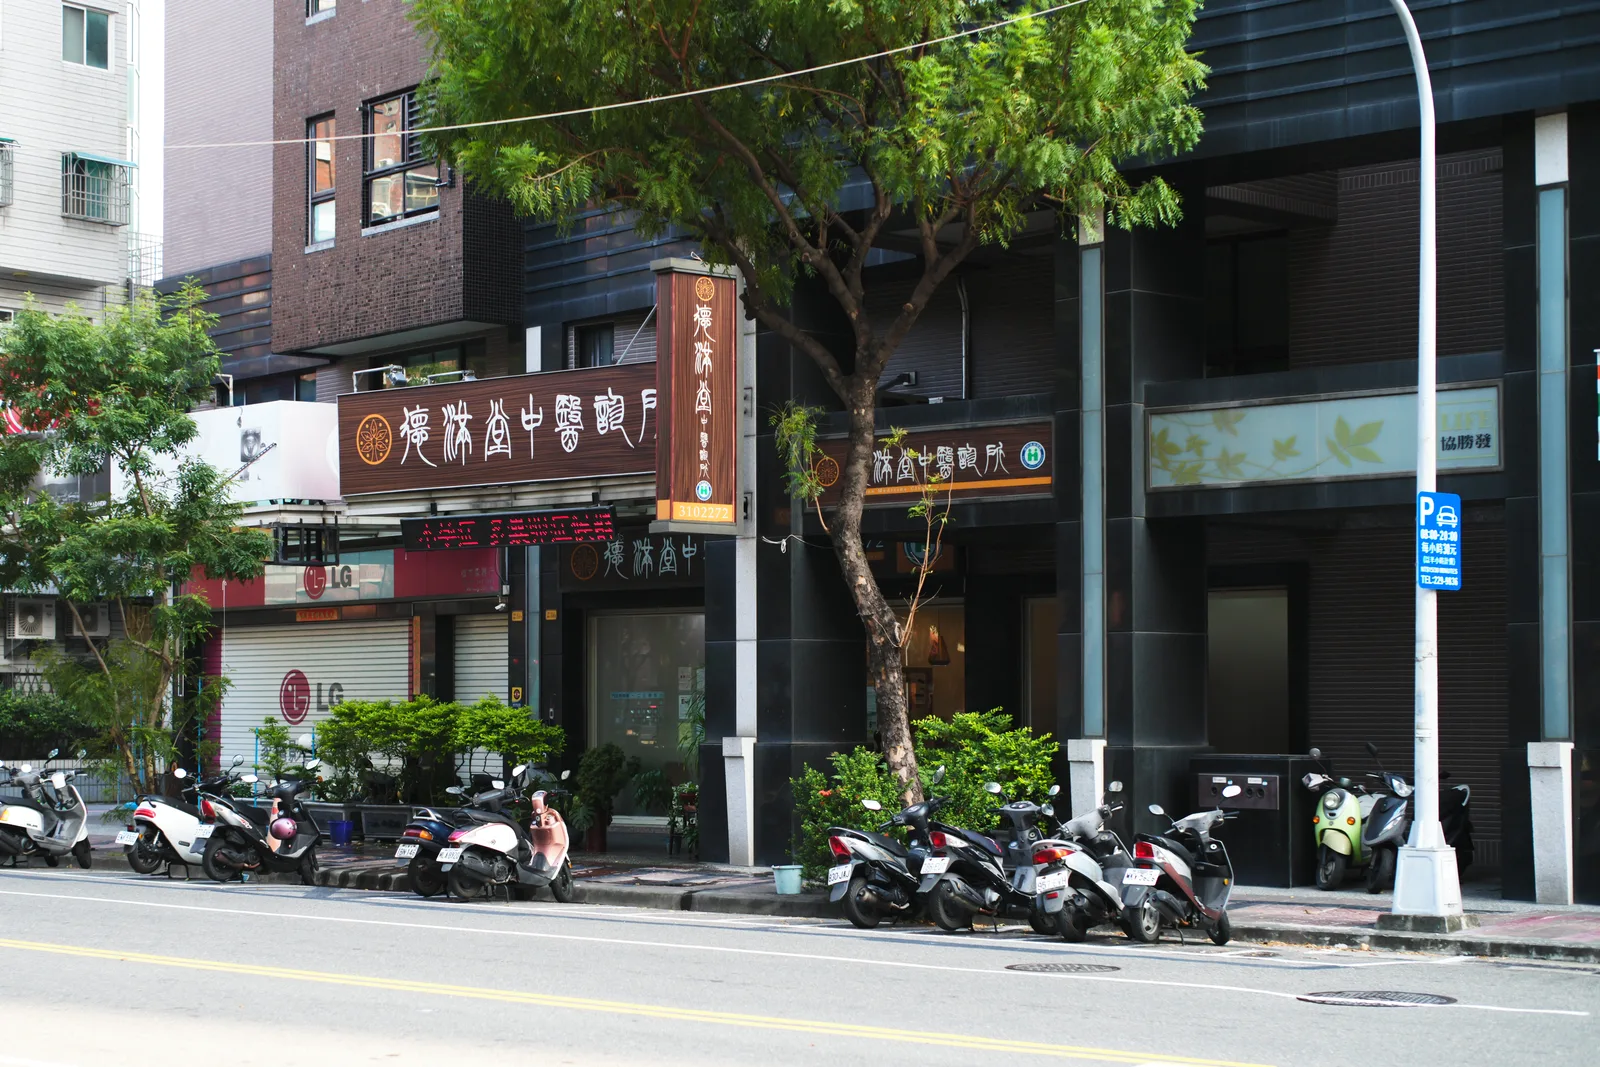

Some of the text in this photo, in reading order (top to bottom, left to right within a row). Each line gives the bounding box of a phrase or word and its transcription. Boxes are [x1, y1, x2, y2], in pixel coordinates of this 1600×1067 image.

[1441, 409, 1493, 432] LIFE
[1440, 433, 1492, 452] 協勝發
[872, 441, 1010, 485] 滿堂中醫診所
[679, 505, 729, 519] 3102272
[1419, 496, 1435, 526] P
[331, 565, 352, 589] LG
[316, 682, 344, 712] LG
